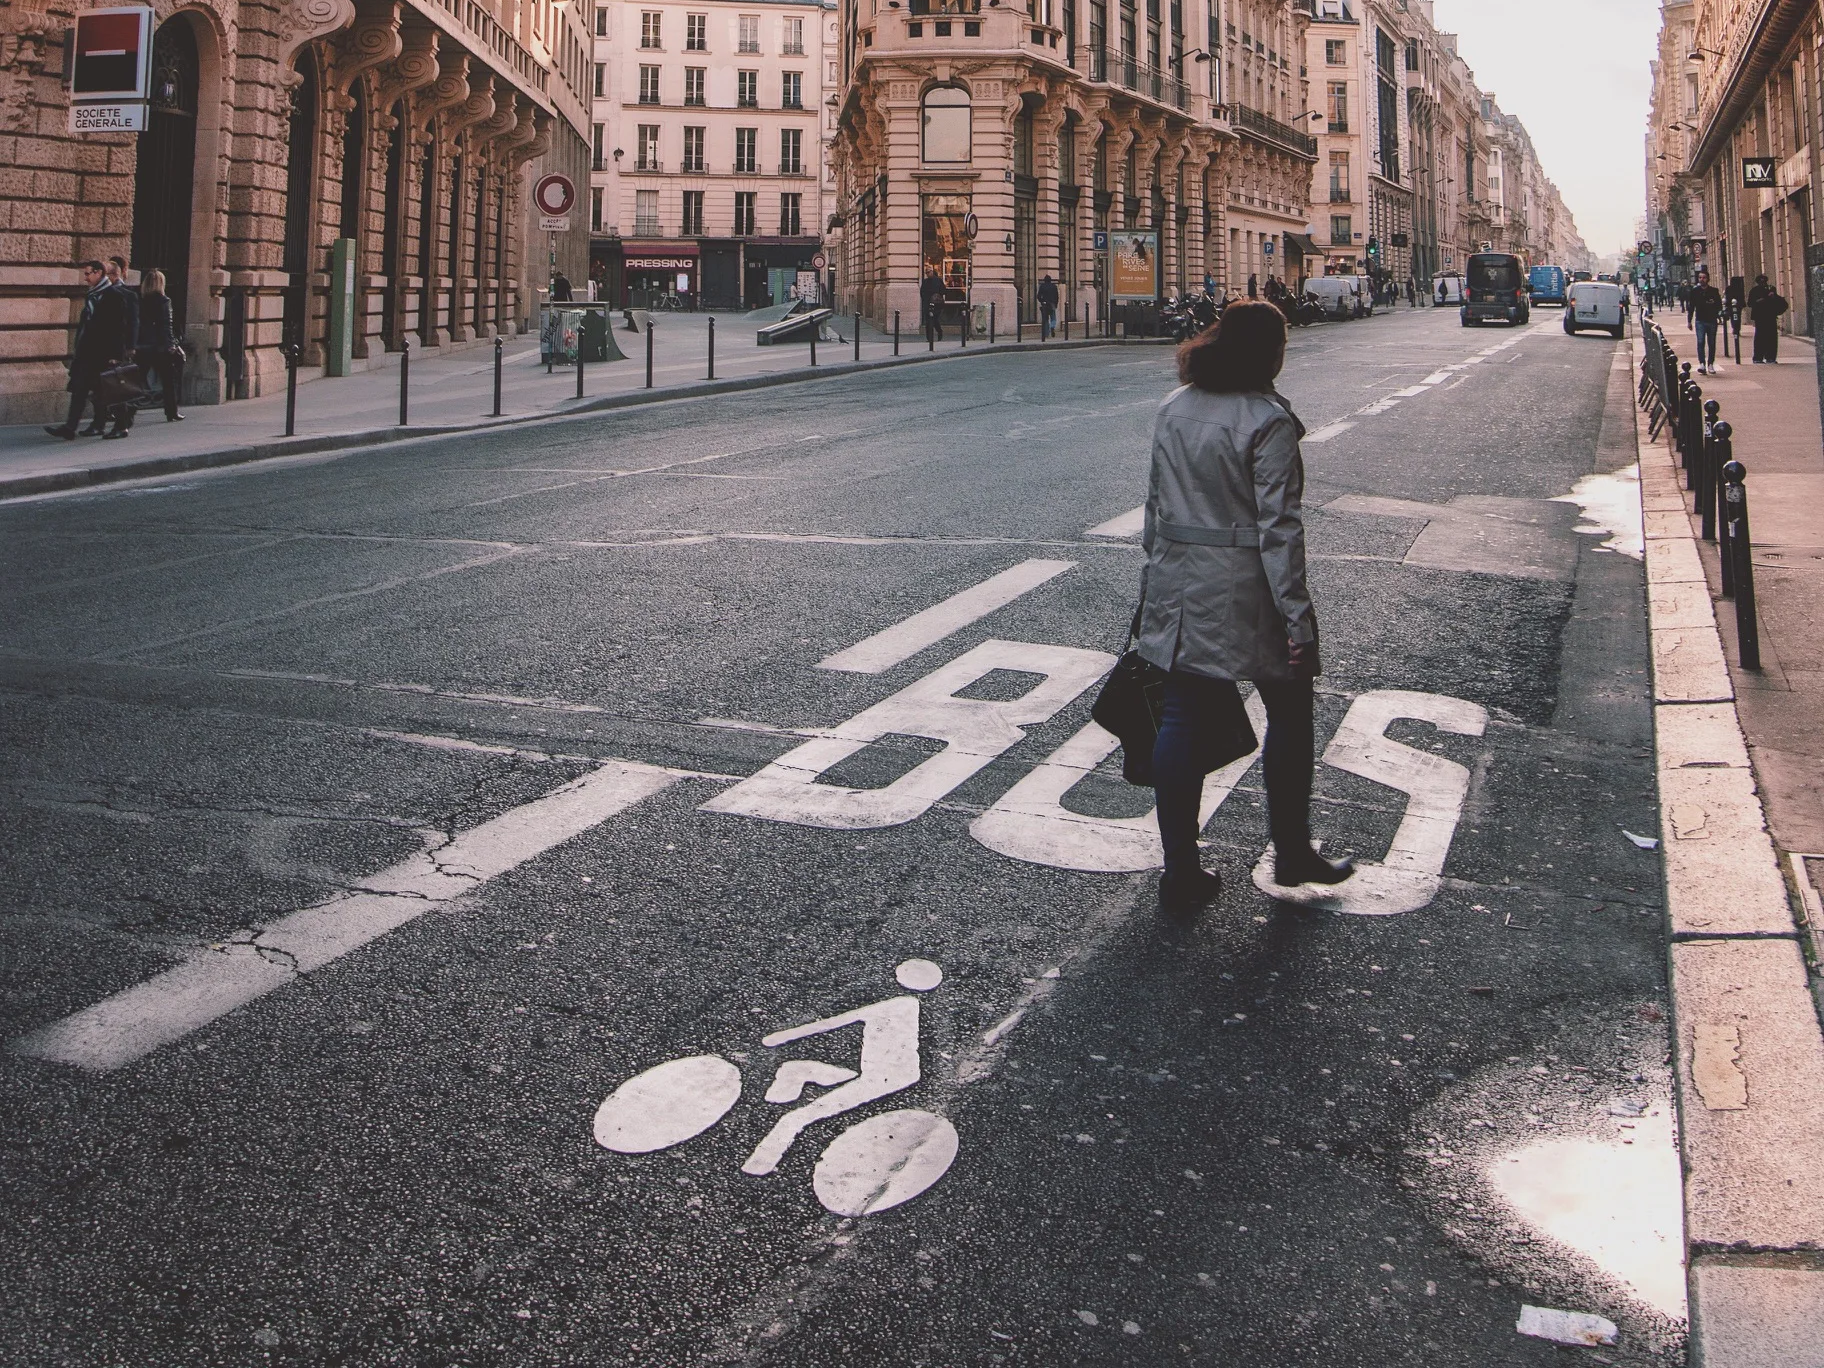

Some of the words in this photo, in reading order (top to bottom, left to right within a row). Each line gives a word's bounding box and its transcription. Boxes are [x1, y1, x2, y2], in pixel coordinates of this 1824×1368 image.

[76, 108, 121, 119] SOCIETE
[75, 118, 133, 128] GENERALE
[1097, 235, 1104, 247] P
[625, 259, 693, 267] PRESSING
[700, 639, 1487, 916] BUS
